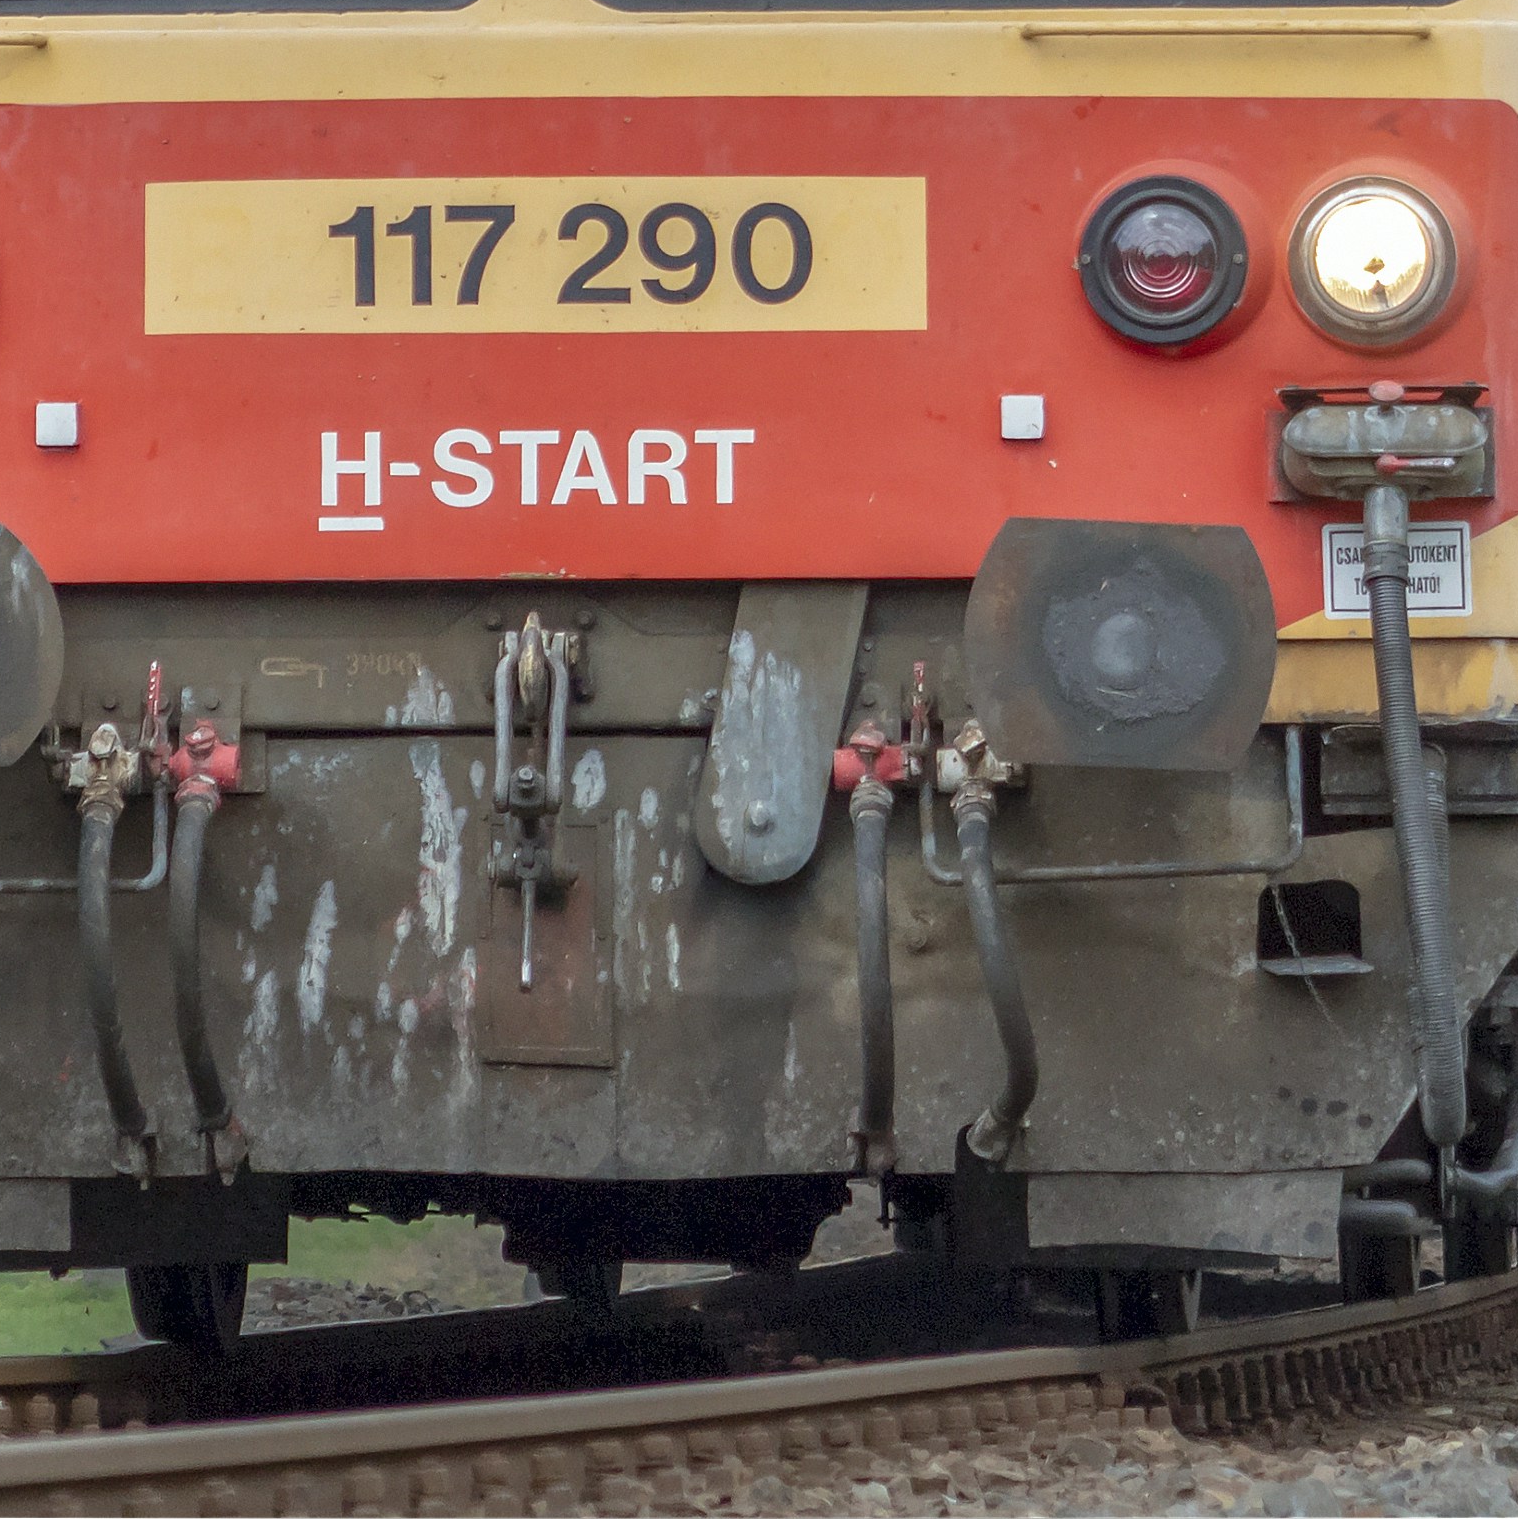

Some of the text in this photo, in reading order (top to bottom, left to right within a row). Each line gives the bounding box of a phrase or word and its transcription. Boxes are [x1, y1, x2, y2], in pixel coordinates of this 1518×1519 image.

[329, 202, 814, 307] 117 290
[319, 427, 756, 511] H-START
[1336, 541, 1458, 565] CSA UTÓKÉNT
